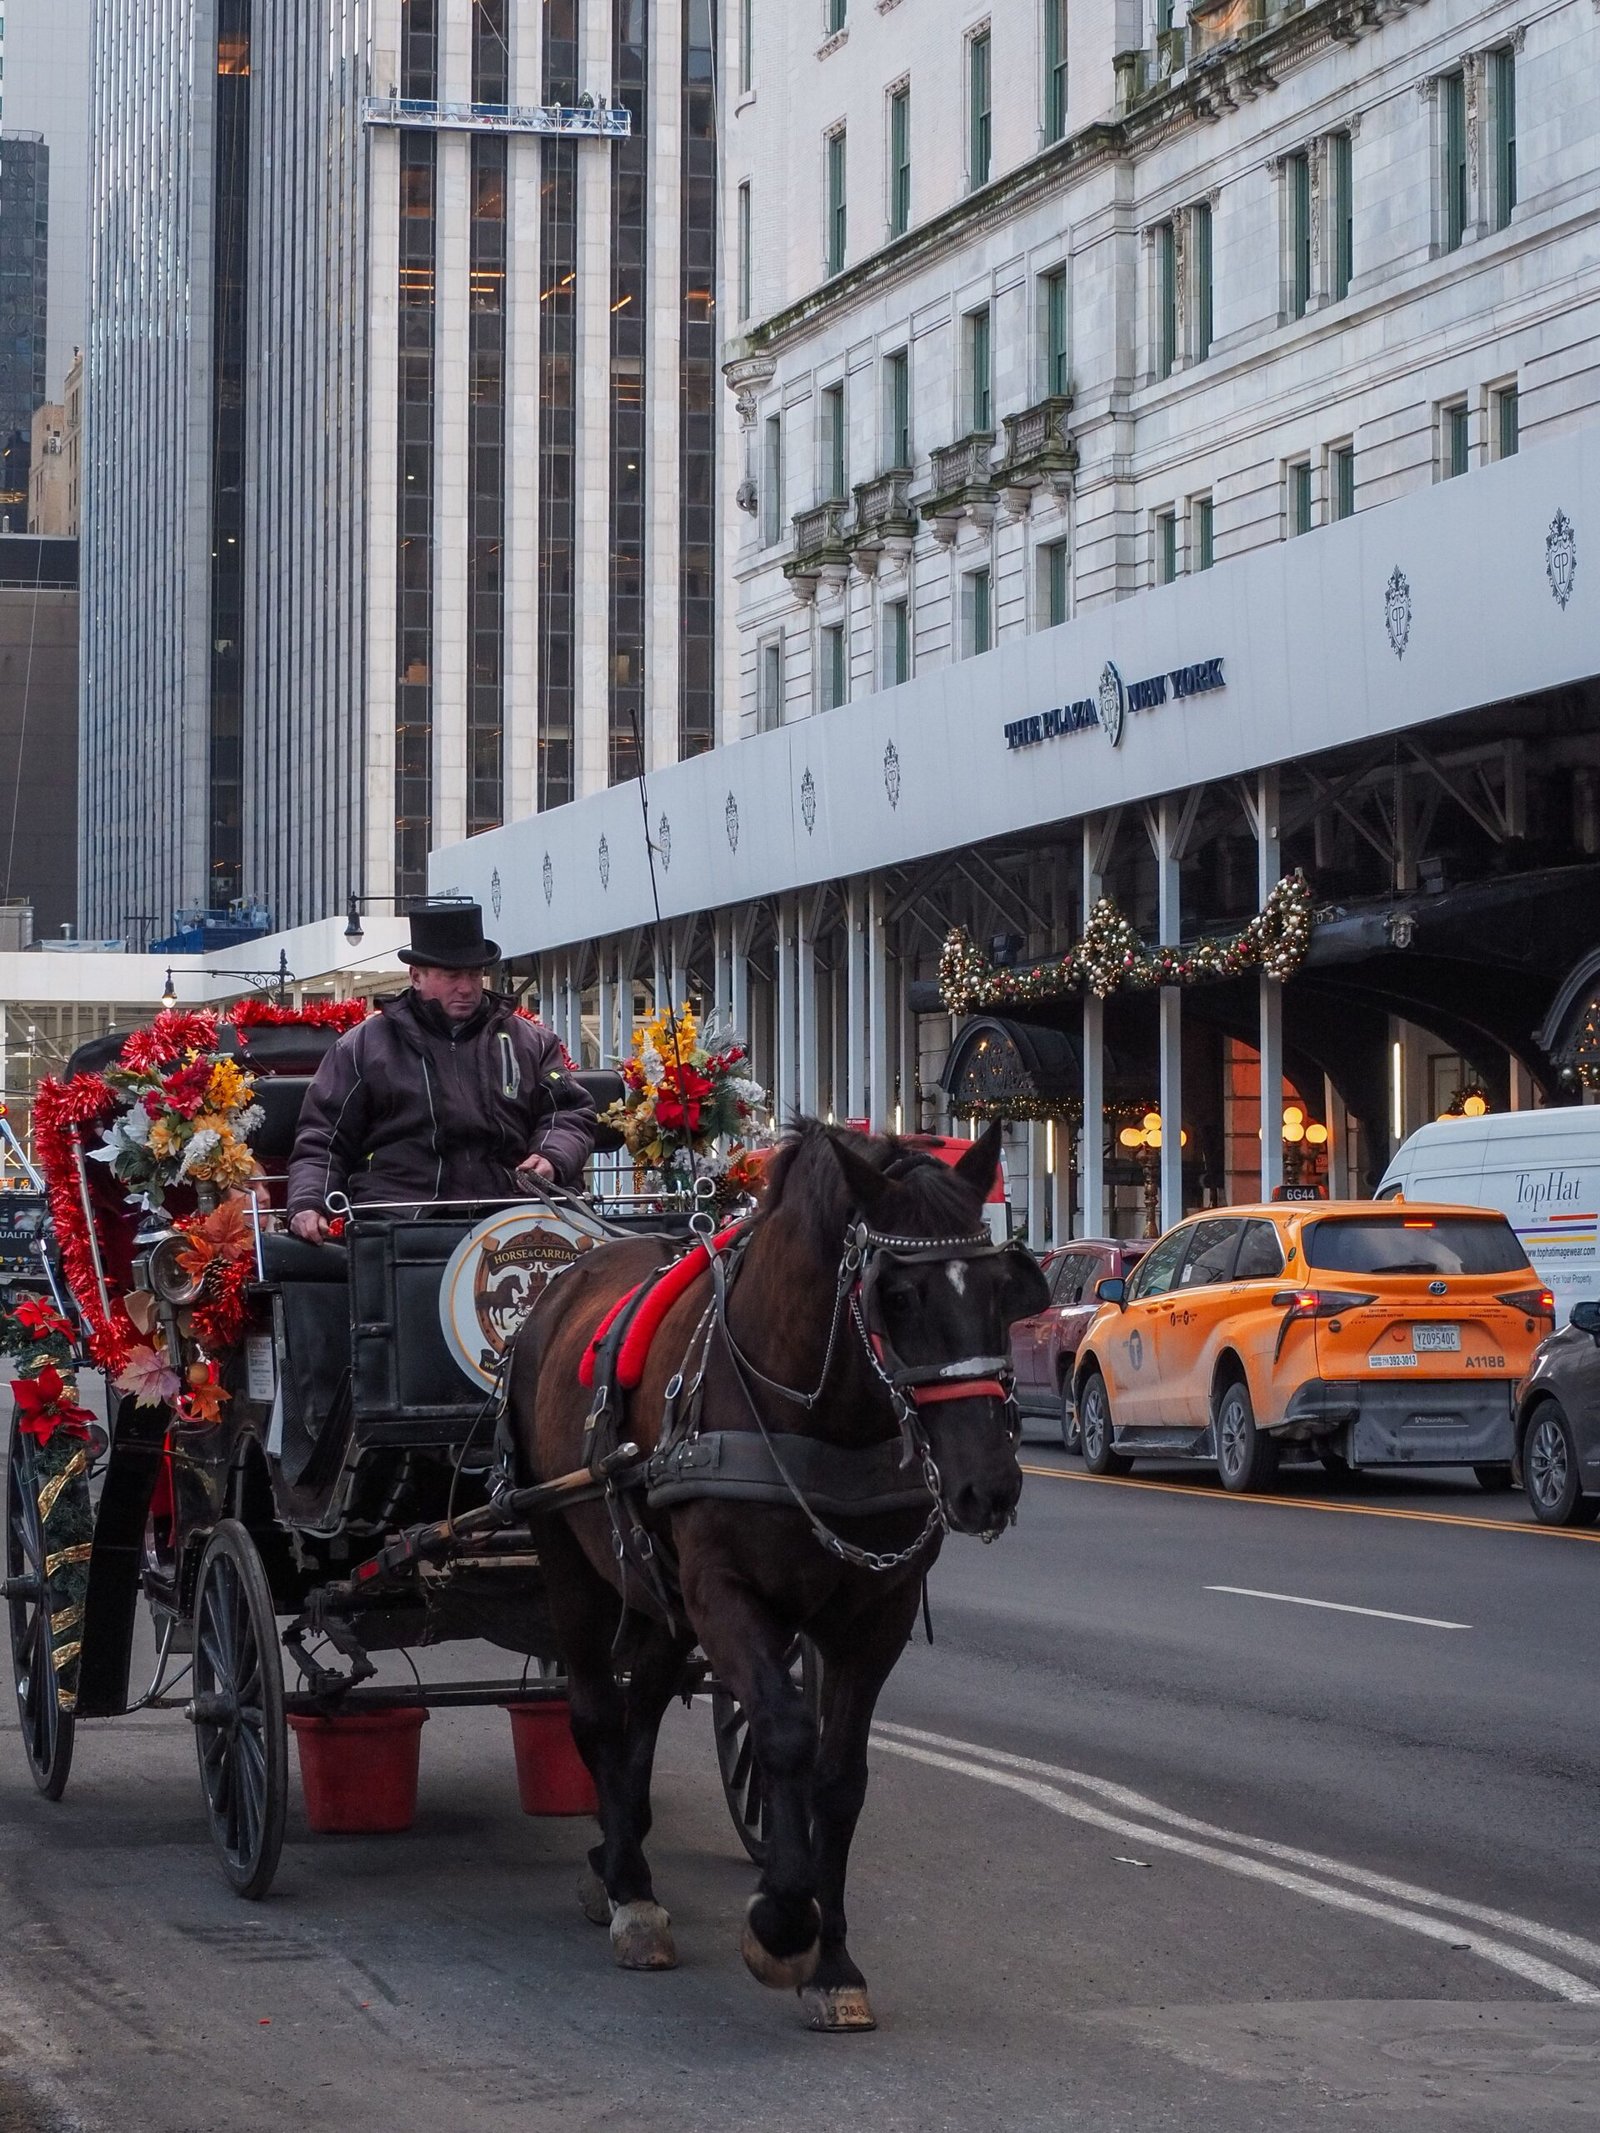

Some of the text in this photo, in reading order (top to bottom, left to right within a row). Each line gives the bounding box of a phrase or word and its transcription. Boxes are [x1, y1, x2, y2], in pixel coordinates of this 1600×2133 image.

[1004, 657, 1226, 749] THE PLAZA NEW YORK
[1287, 1189, 1315, 1200] 6G44
[1516, 1171, 1582, 1212] TopHat
[0, 1231, 34, 1239] UALITY
[1416, 1332, 1456, 1345] Y209540C
[1389, 1355, 1416, 1366] 392-3013
